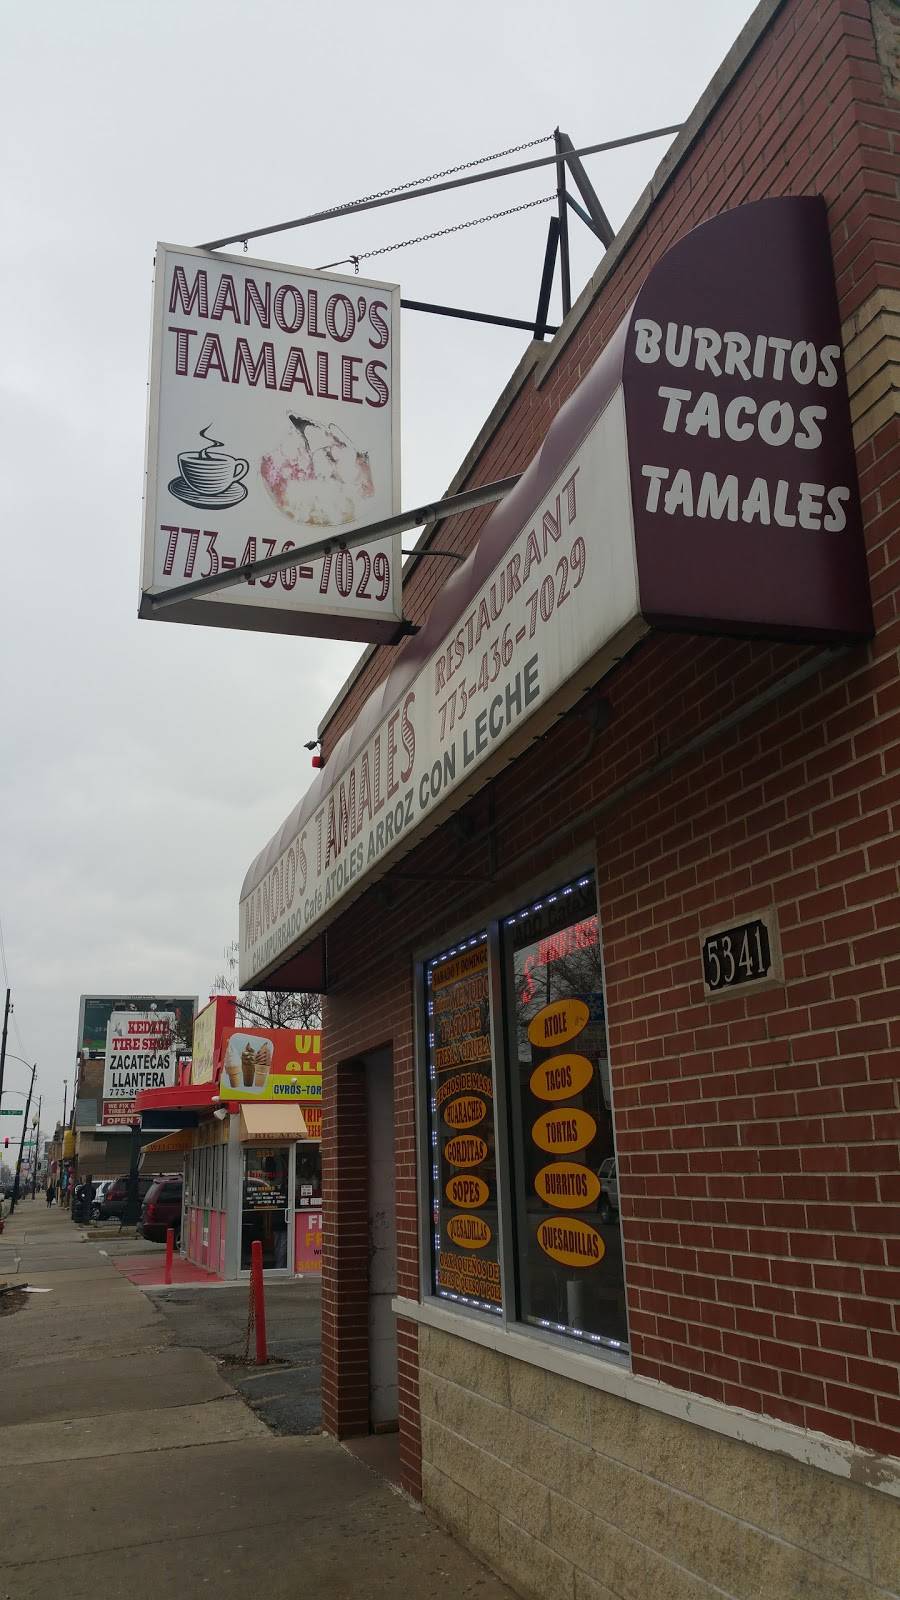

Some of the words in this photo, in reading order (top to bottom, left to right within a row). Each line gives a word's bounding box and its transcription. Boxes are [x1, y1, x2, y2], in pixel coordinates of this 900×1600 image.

[168, 265, 389, 350] MANOLO'S
[168, 326, 389, 408] TAMALES
[635, 319, 840, 388] BURRITOS
[658, 386, 827, 450] TACOS
[642, 465, 850, 532] TAMALES
[160, 524, 390, 601] 773-436-7029
[434, 466, 580, 696] RESTAURANT
[438, 536, 586, 743] 773-436-7029
[315, 692, 416, 877] TAMALES
[325, 842, 364, 902] ATOLES
[367, 787, 414, 864] ARROZ
[419, 743, 456, 809] CON
[463, 653, 540, 768] LECHE
[707, 926, 765, 986] 5341
[544, 1012, 567, 1039] ATOLE
[112, 1038, 140, 1050] TIRE
[110, 1055, 170, 1069] ZACATECAS
[545, 1065, 573, 1091] TACOS
[112, 1073, 166, 1087] LLANTERA
[107, 1117, 134, 1125] OPEN
[448, 1100, 482, 1123] HUARACHES
[546, 1119, 577, 1143] TORTAS
[447, 1139, 483, 1161] GORDITAS
[452, 1181, 480, 1202] SOPES
[545, 1173, 588, 1197] BURRITOS
[542, 1225, 599, 1258] QUESADILLAS
